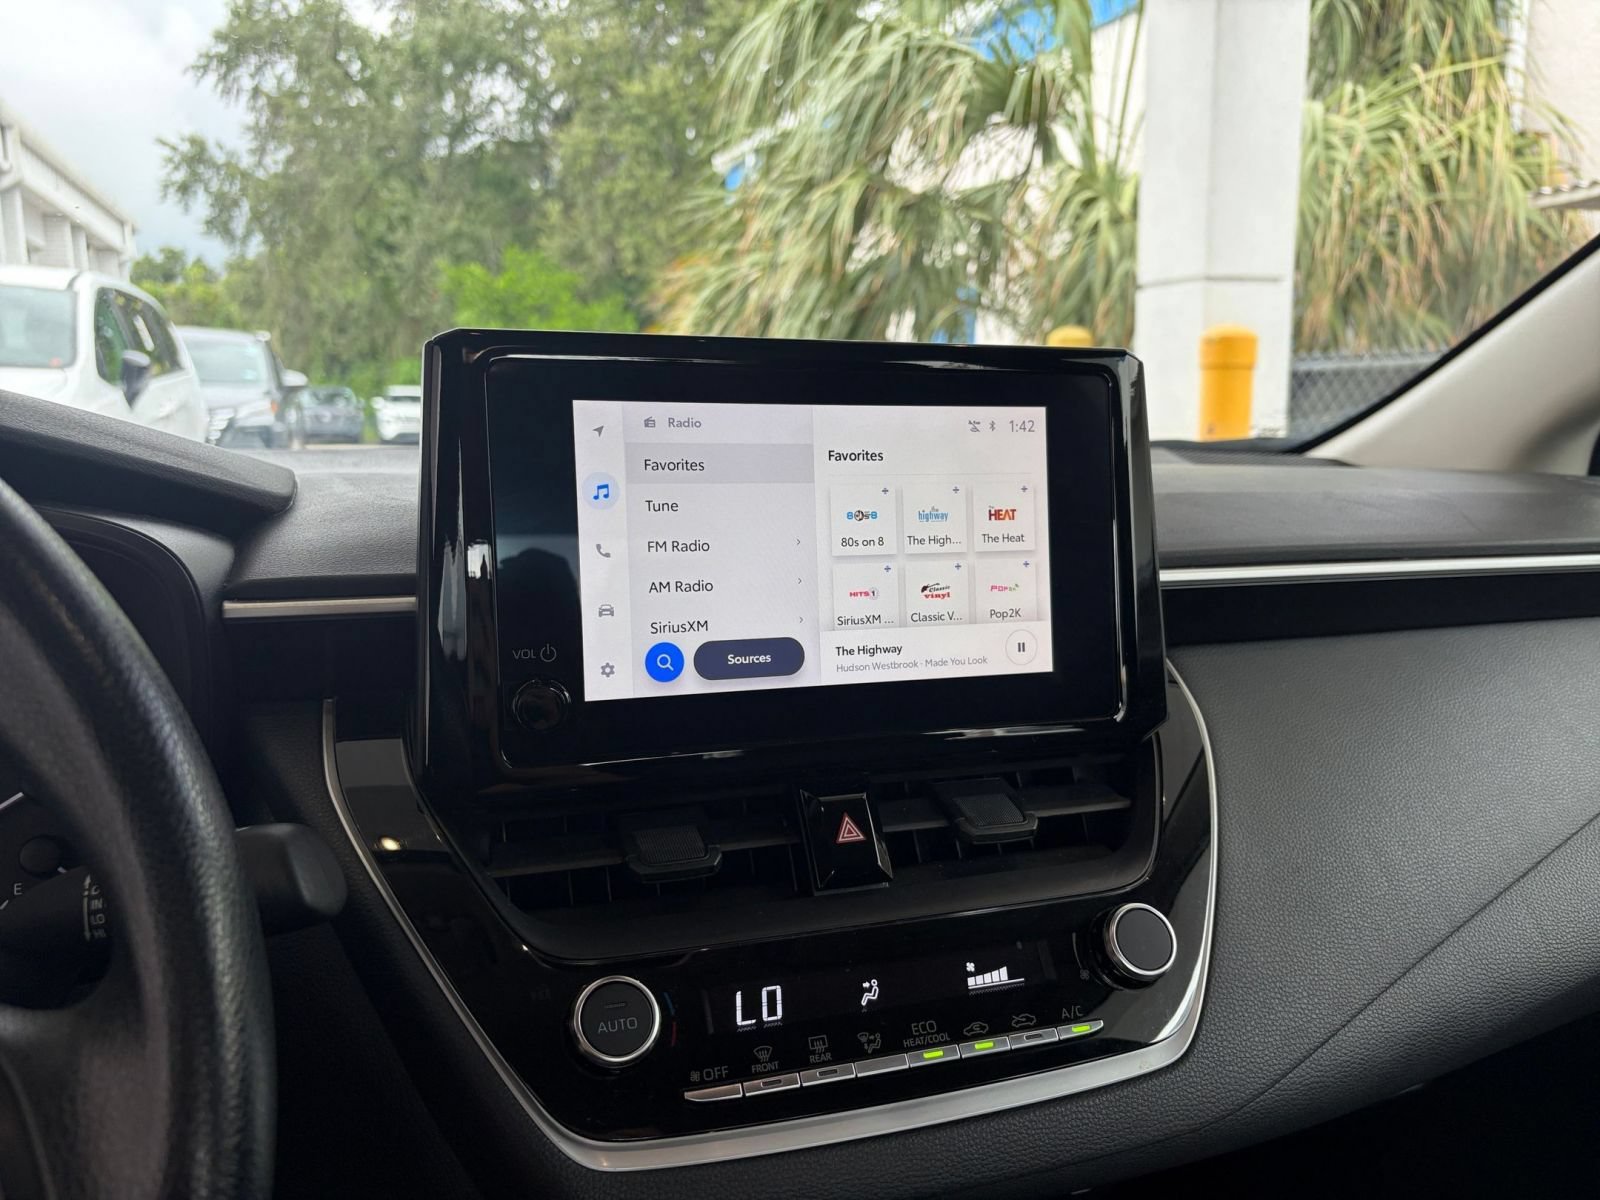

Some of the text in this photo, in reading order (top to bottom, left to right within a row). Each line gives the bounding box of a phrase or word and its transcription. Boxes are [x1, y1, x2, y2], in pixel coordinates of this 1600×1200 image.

[668, 417, 702, 429] Radio
[1009, 420, 1036, 433] 1:42
[828, 449, 884, 462] Favorites
[644, 458, 705, 472] Favorites
[645, 500, 679, 513] Tune
[988, 508, 1016, 521] HEAT
[841, 538, 860, 547] 80s
[877, 537, 885, 547] 8
[907, 536, 926, 546] The
[982, 533, 1025, 543] The Heat
[647, 540, 710, 553] FM Radio
[649, 580, 714, 594] AM Radio
[910, 611, 946, 623] Classic
[989, 607, 1022, 620] Pop2K
[650, 619, 709, 634] SiriusXM
[837, 614, 882, 627] SiriusXM
[512, 649, 537, 659] VOL
[836, 644, 903, 658] The Highway
[727, 652, 772, 665] Sources
[836, 655, 988, 673] Hudson Westbrook Made You Look
[14, 883, 22, 895] E
[736, 985, 783, 1027] LO
[1061, 1005, 1084, 1020] A/C
[597, 1016, 639, 1034] AUTO
[911, 1020, 937, 1035] ECO
[903, 1032, 951, 1048] HEAT/COOL
[809, 1052, 833, 1064] REAR
[703, 1065, 729, 1082] OFF
[752, 1061, 780, 1074] FRONT
